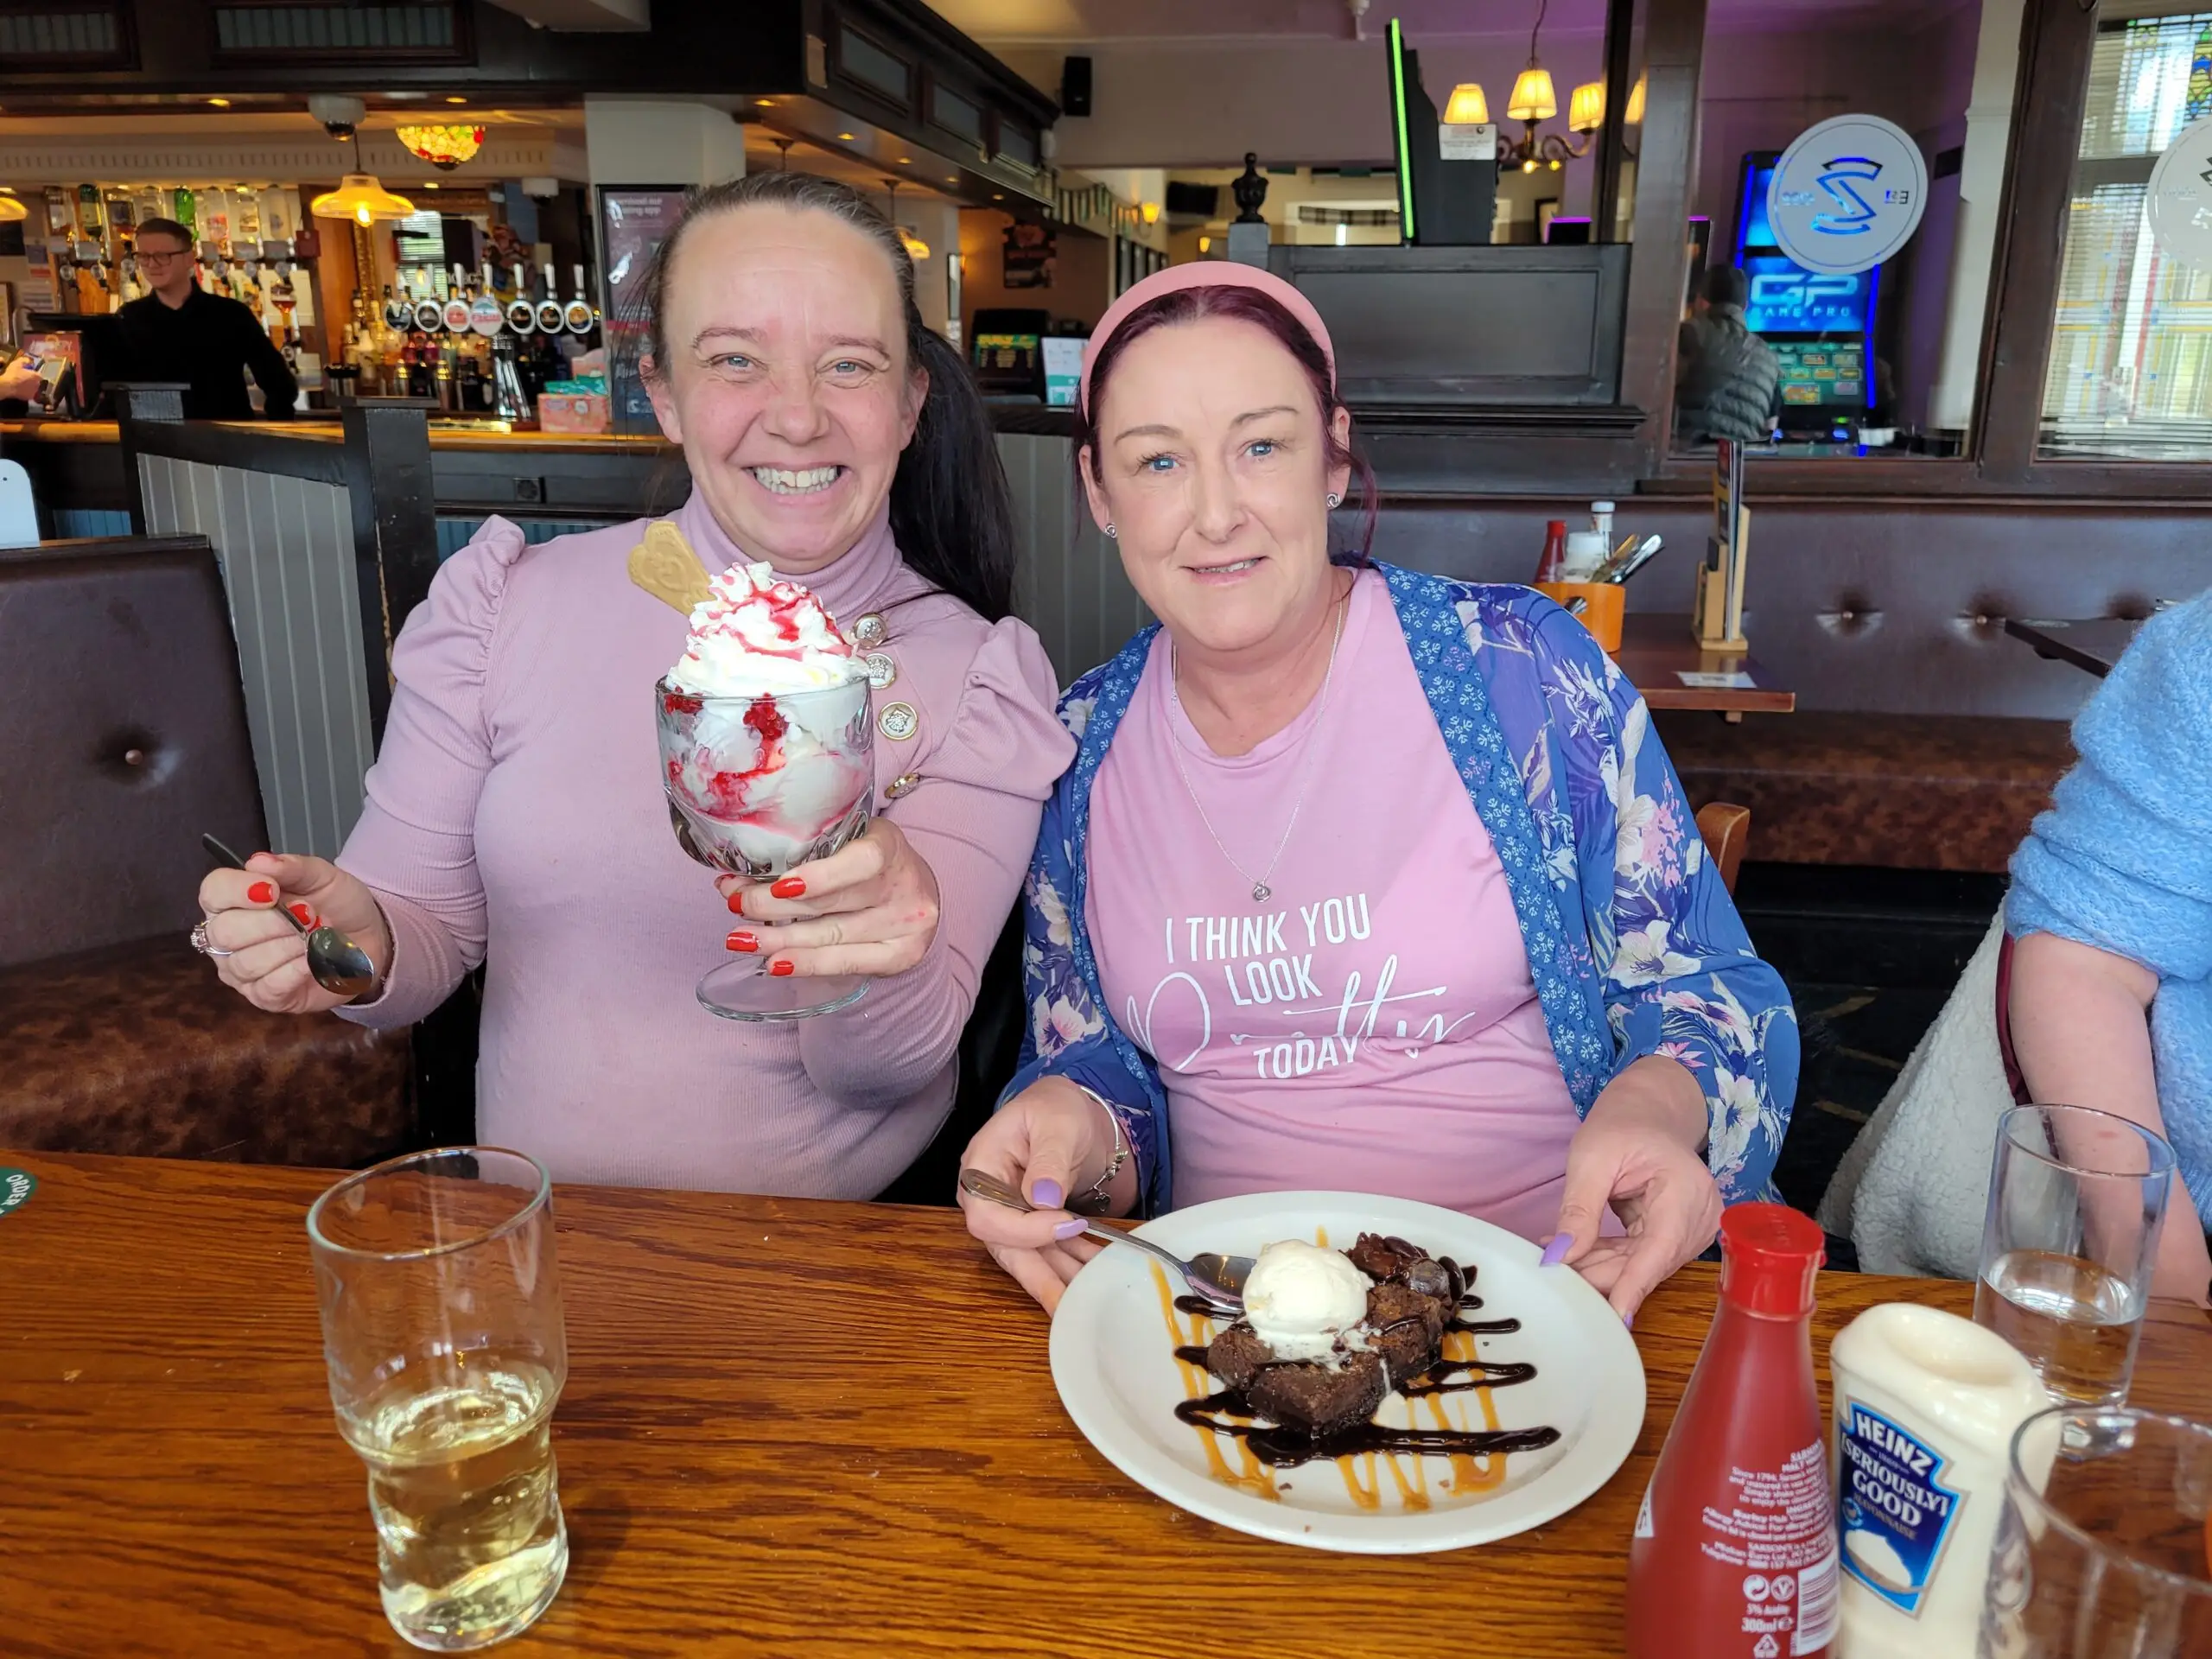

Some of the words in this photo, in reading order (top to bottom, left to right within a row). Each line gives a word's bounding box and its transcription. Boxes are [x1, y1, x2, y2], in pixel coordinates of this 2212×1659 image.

[1812, 306, 1851, 318] PRO
[1166, 918, 1174, 963] I
[1185, 911, 1287, 962] THINK
[1300, 893, 1371, 947] YOU
[1224, 953, 1323, 1006] LOOK
[1254, 1035, 1360, 1078] TODAY
[1856, 1412, 1933, 1478] HEINZ
[1852, 1469, 1923, 1527] GOOD
